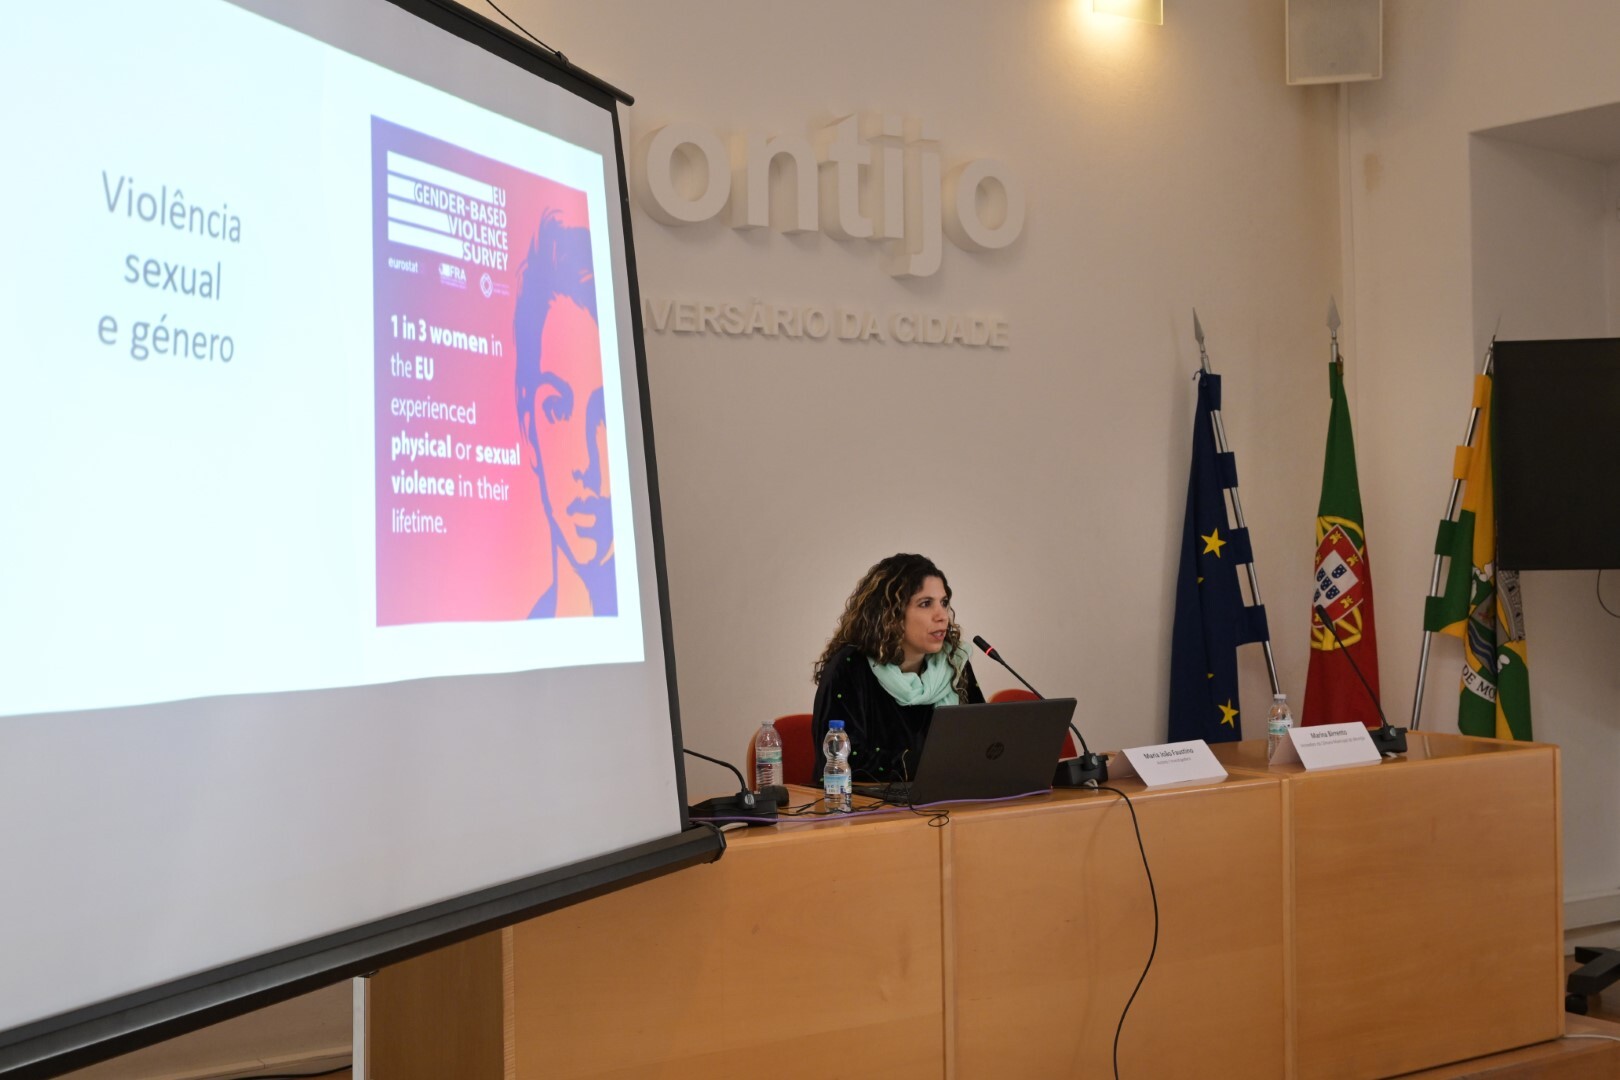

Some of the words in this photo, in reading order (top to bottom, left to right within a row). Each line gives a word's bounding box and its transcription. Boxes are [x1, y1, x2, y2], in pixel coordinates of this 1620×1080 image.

[101, 169, 241, 243] Violência
[414, 182, 507, 229] GENDER-BASED
[493, 186, 506, 207] EU
[449, 215, 508, 251] VIOLENCE
[388, 257, 419, 273] eurostat
[463, 241, 508, 271] SURVEY
[124, 254, 221, 301] sexual
[449, 263, 467, 282] FRA
[98, 315, 118, 345] e
[130, 313, 234, 363] género
[391, 315, 399, 338] 1
[402, 315, 416, 342] in
[418, 319, 427, 342] 3
[429, 325, 488, 355] women
[491, 334, 503, 357] in
[837, 310, 885, 343] DA
[893, 312, 1011, 349] CIDADE
[391, 352, 412, 378] the
[415, 356, 434, 381] EU
[391, 395, 476, 425] experienced
[391, 430, 452, 461] physical
[455, 442, 472, 460] or
[475, 443, 521, 466] sexual
[391, 469, 455, 496] violence
[458, 475, 473, 498] in
[477, 476, 509, 501] their
[392, 508, 447, 534] lifetime.
[1463, 664, 1476, 684] DE
